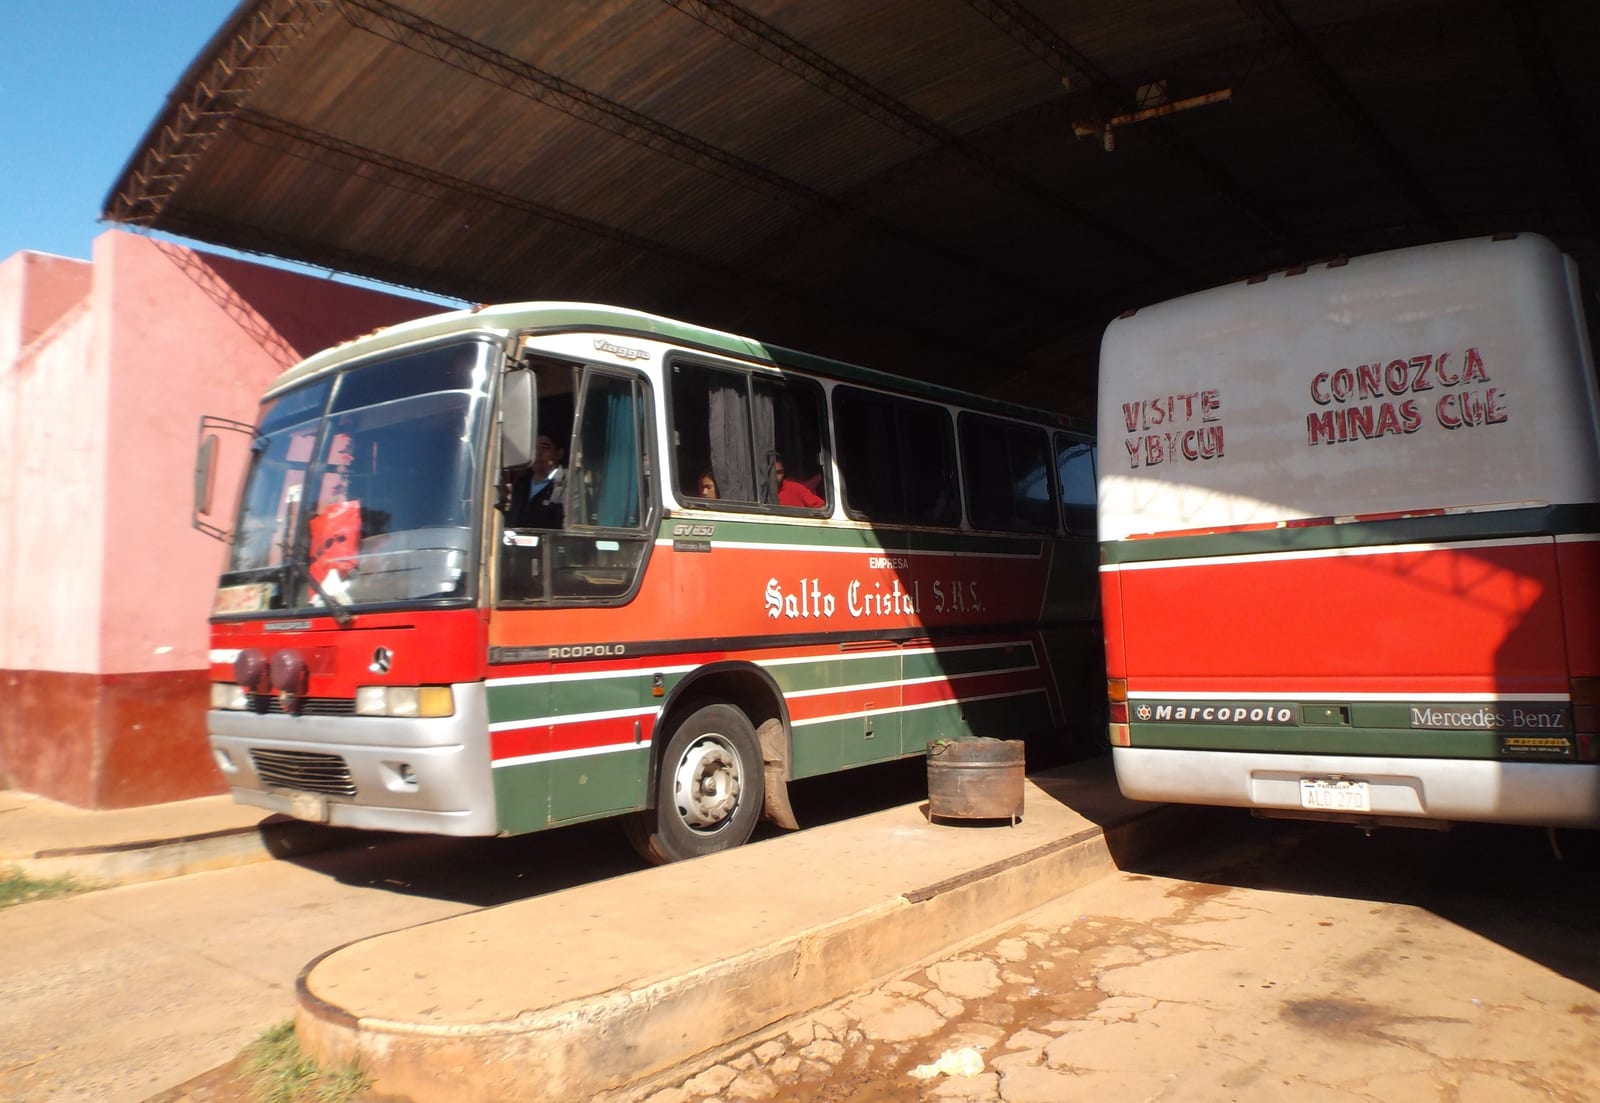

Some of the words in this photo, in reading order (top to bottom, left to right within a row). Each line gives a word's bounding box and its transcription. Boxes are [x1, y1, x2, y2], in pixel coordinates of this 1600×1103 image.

[1311, 347, 1491, 406] CONOZCA
[1122, 389, 1222, 433] VISITE
[1307, 399, 1423, 446] MINAS
[1435, 387, 1508, 430] CUE
[869, 557, 909, 569] EMPRESA
[764, 577, 836, 619] Salto
[847, 578, 921, 619] Cristal
[1155, 705, 1292, 722] Marcopolo
[1411, 707, 1564, 728] Mercedes-Benz
